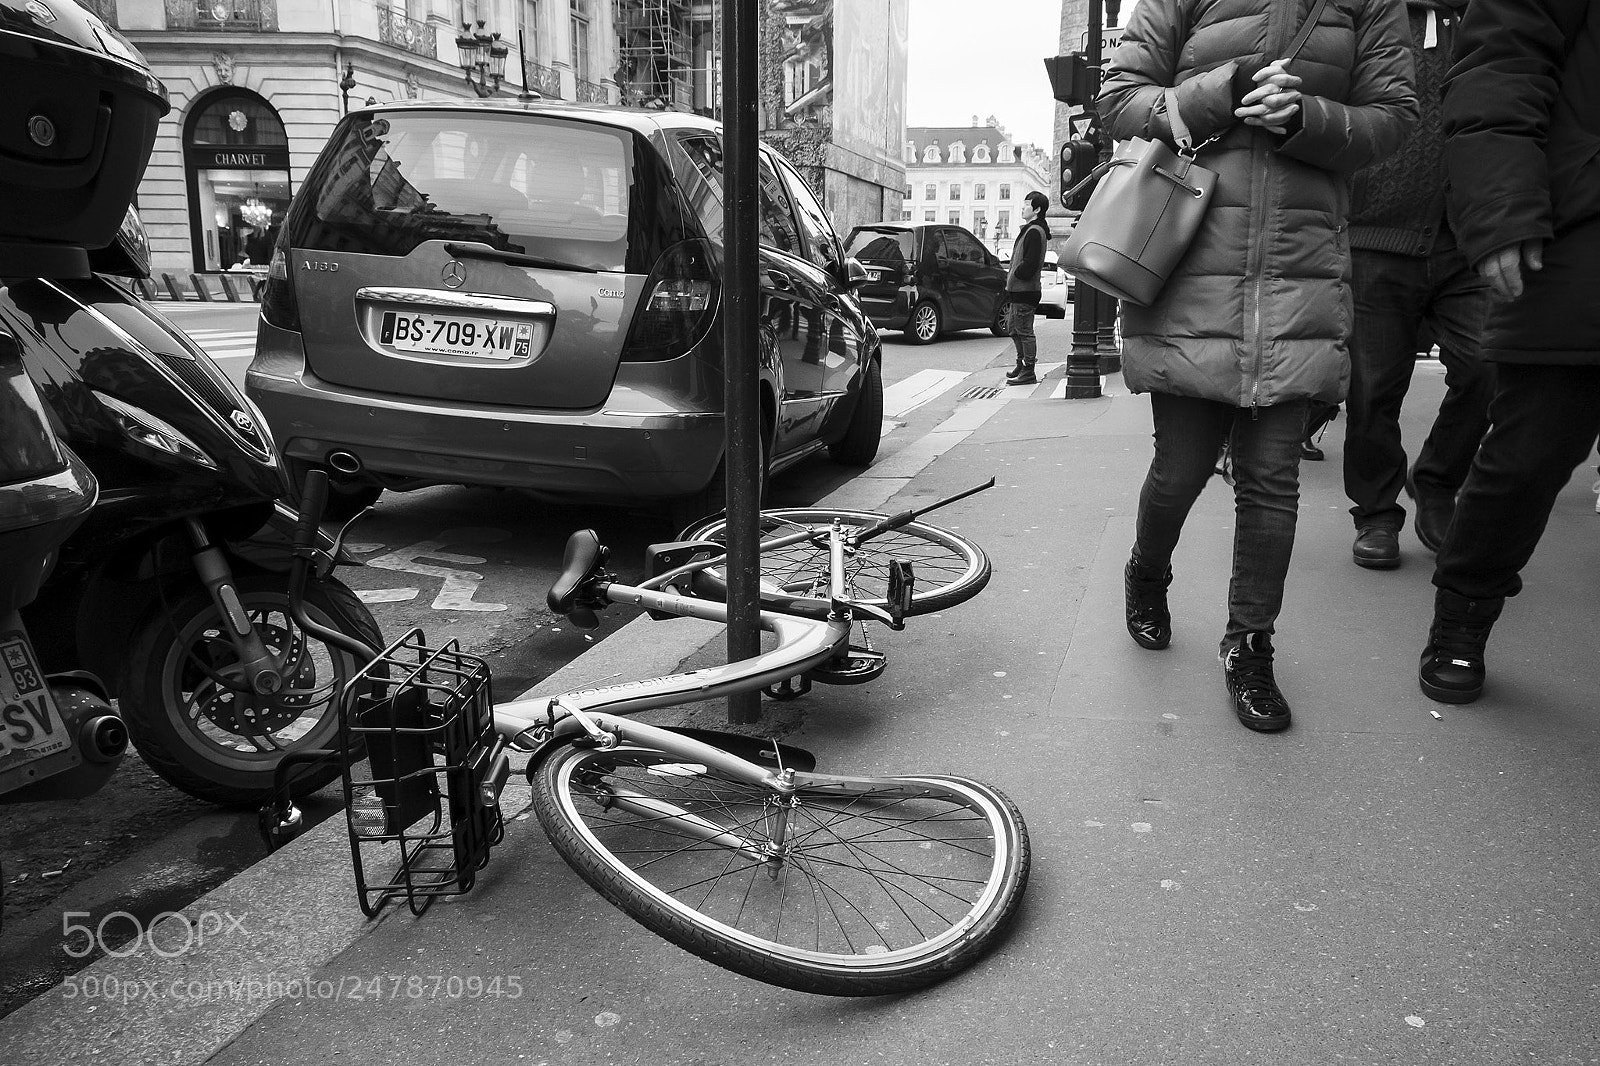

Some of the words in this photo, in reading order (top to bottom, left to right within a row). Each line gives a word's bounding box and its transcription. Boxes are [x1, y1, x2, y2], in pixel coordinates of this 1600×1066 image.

[215, 153, 267, 166] CHARVET
[395, 317, 514, 351] BS-709-XW
[515, 341, 529, 355] 75
[14, 668, 37, 690] 93
